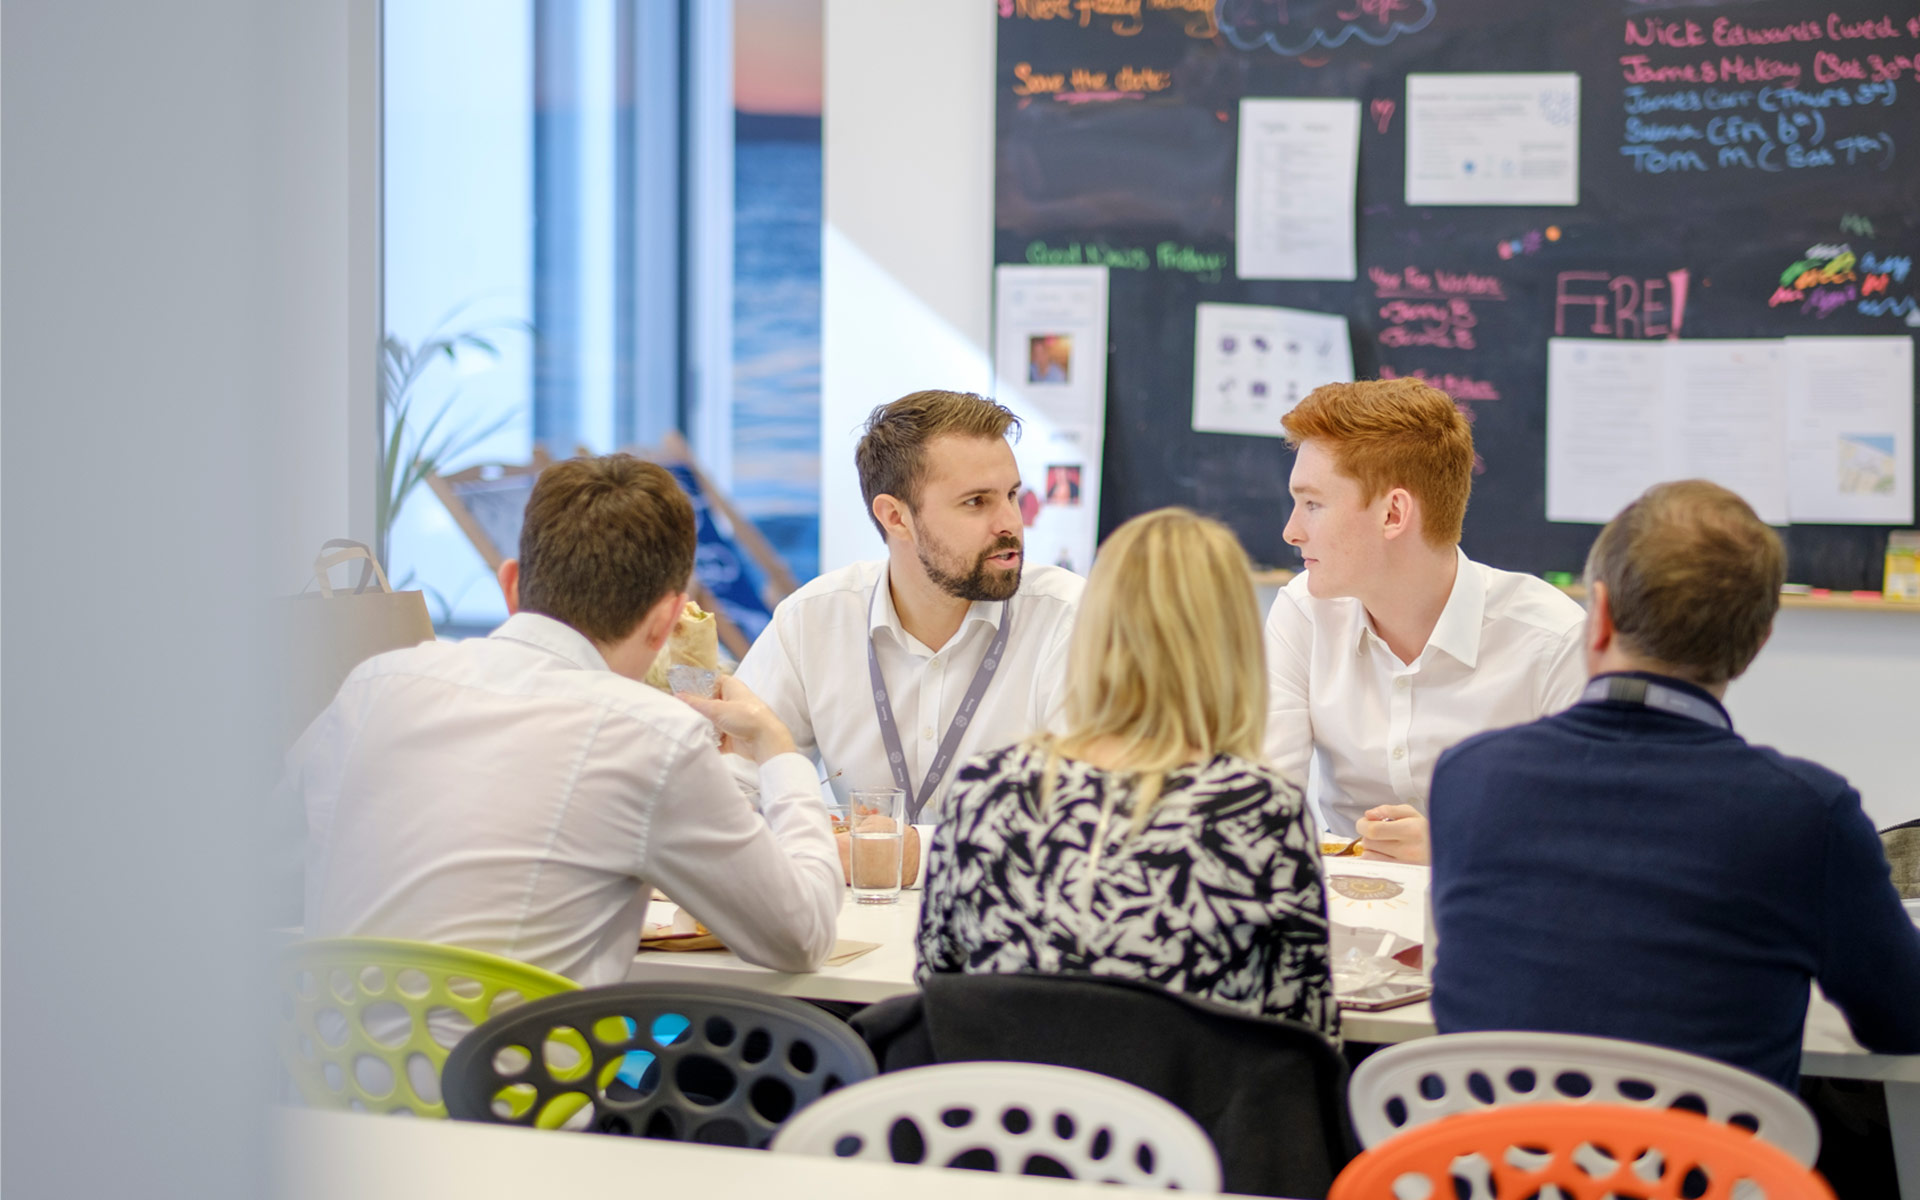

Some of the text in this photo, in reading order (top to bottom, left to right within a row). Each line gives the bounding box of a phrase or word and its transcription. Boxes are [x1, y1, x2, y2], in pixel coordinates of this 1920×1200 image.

[1624, 17, 1707, 47] Nick
[1712, 16, 1823, 47] Edwards
[1012, 62, 1066, 95] Save
[1070, 68, 1110, 92] the
[1619, 54, 1718, 84] James
[1623, 85, 1703, 115] James
[1619, 145, 1709, 174] Tom
[1025, 240, 1082, 264] Good
